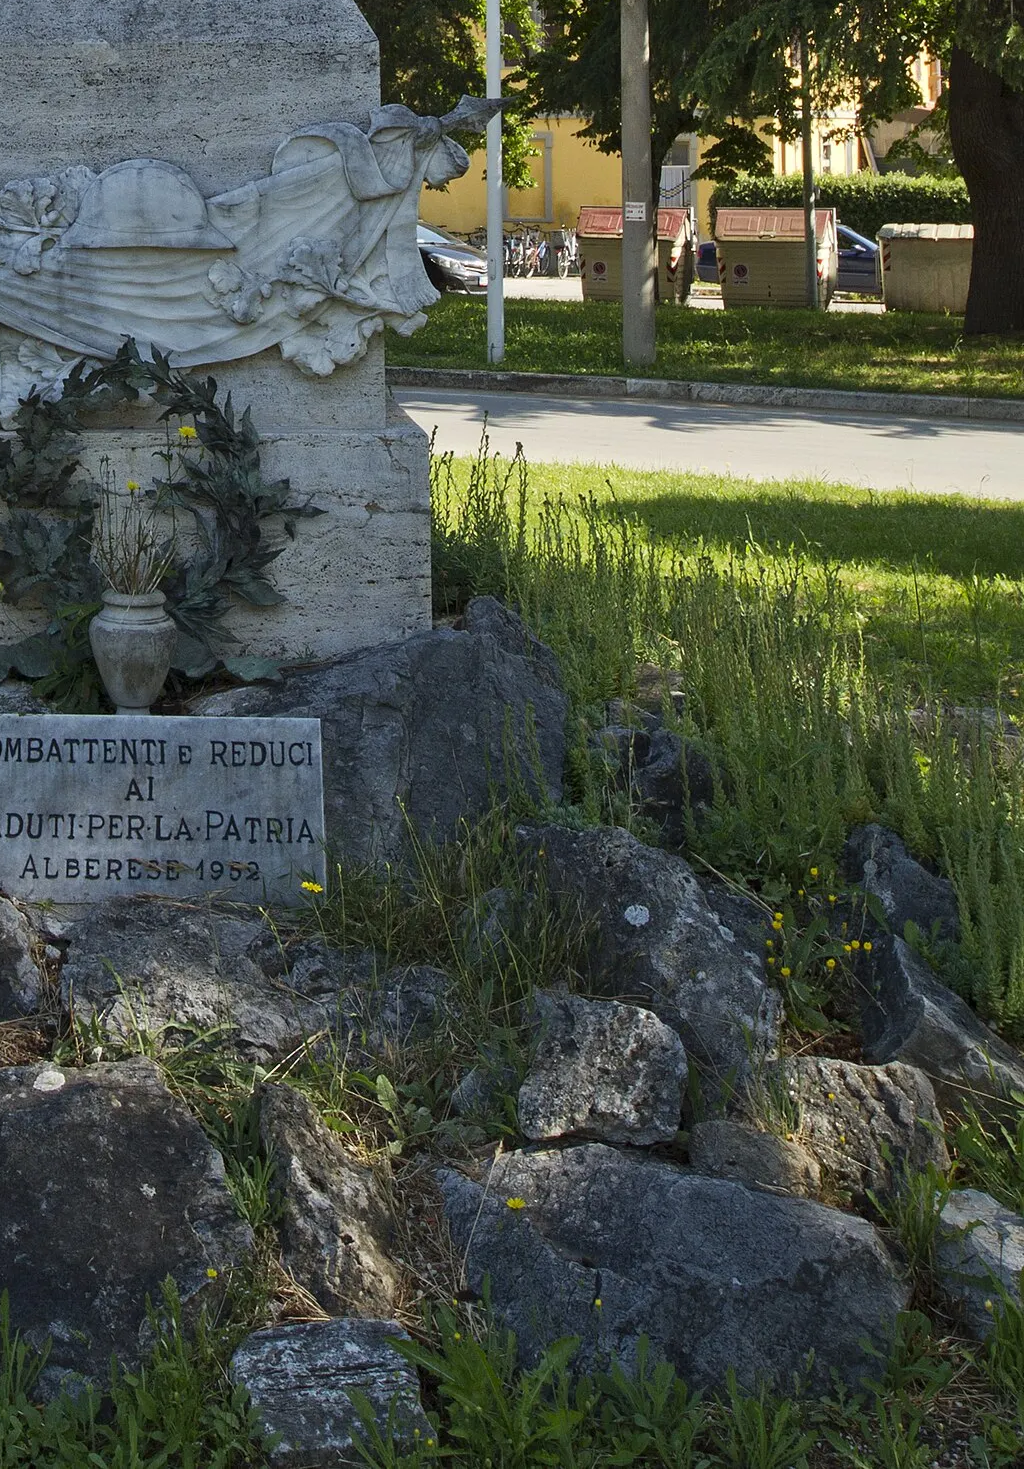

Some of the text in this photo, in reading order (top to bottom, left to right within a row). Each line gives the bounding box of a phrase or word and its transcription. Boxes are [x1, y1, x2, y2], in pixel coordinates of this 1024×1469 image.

[210, 740, 313, 768] REDUCI
[124, 776, 155, 802] AI
[19, 853, 261, 883] ALBERESE 1952
